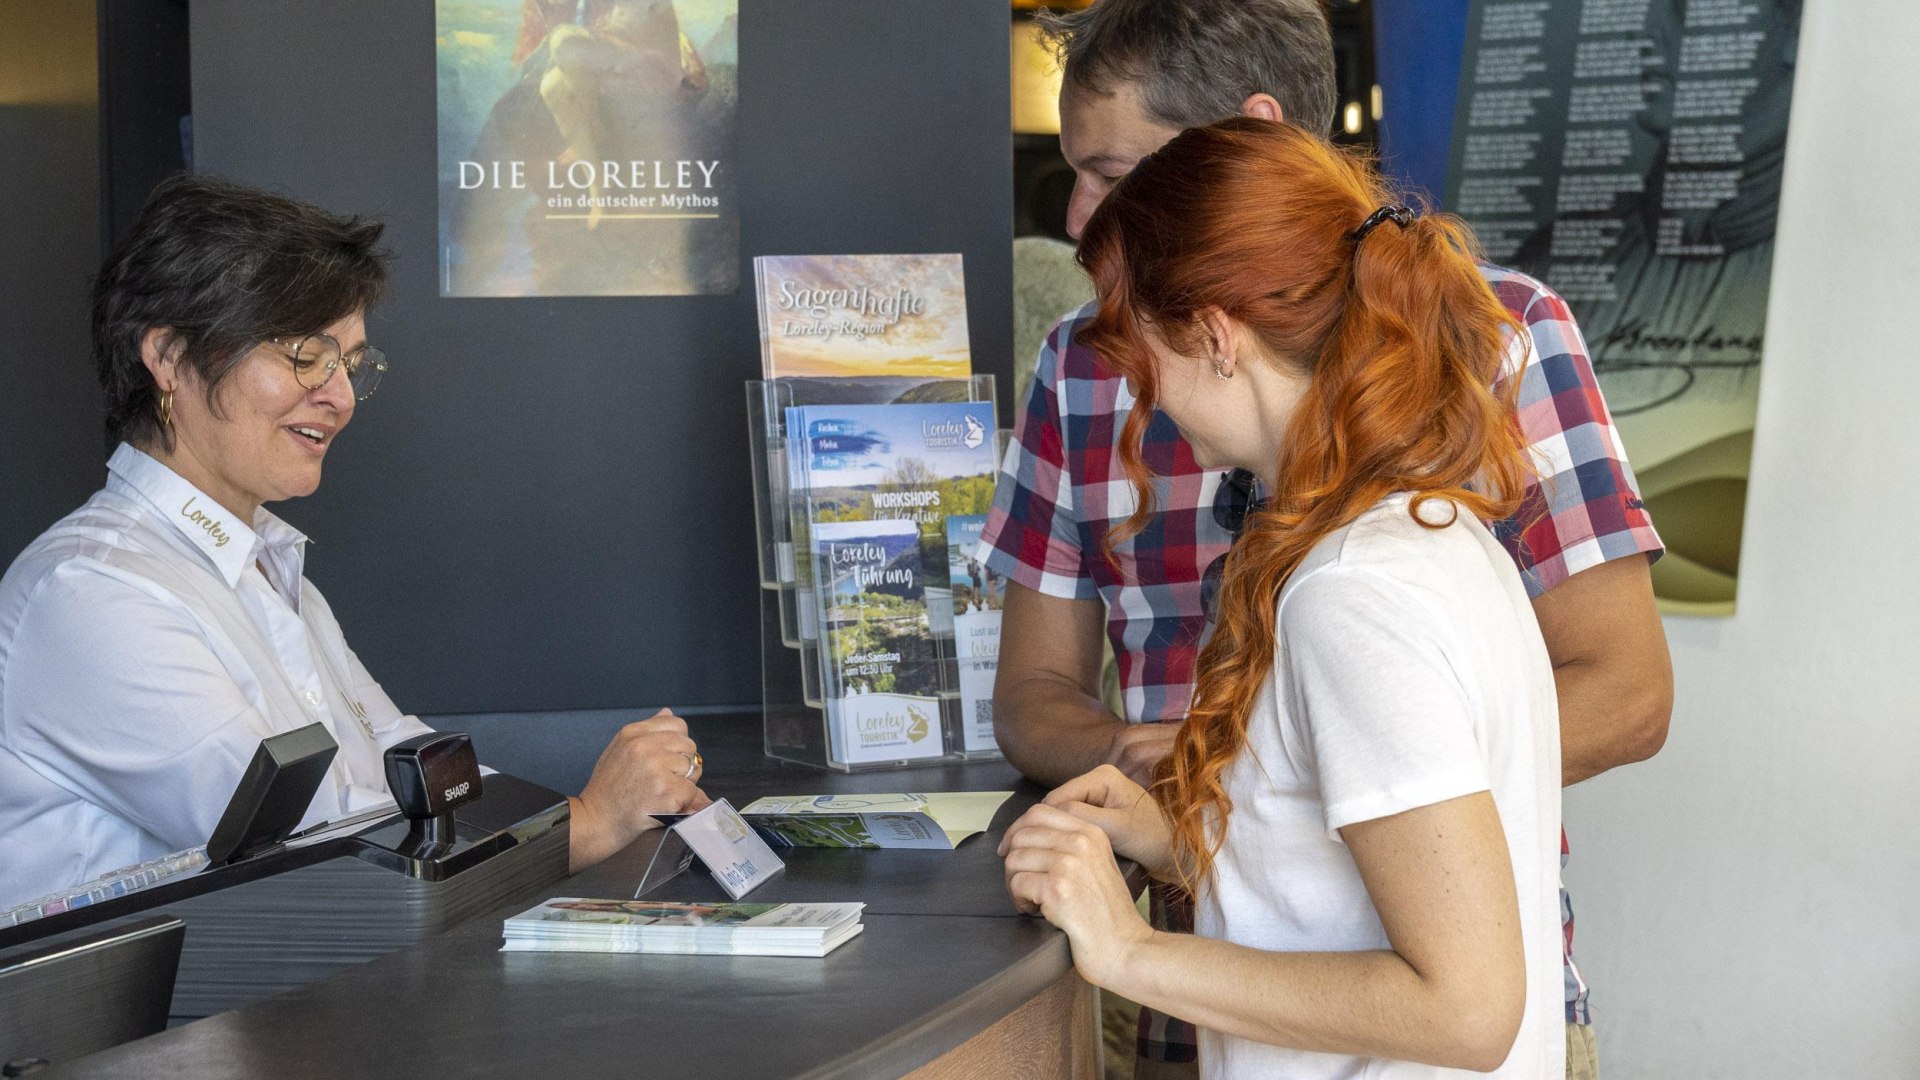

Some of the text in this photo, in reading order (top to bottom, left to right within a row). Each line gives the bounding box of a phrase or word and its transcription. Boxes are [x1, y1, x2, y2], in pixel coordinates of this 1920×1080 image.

[458, 160, 720, 190] DIE LORELEY
[547, 193, 719, 210] ein deutscher Mythos
[779, 281, 923, 325] Sagenhafte
[783, 319, 886, 341] Loreley-Region
[922, 418, 964, 441] Loreley
[871, 490, 940, 508] WORKSHOPS
[181, 496, 230, 548] Loreley
[830, 542, 886, 567] Loreley
[846, 668, 858, 676] um
[856, 711, 905, 733] Loreley
[860, 732, 900, 743] TOURISTIK
[444, 781, 470, 802] SHARP
